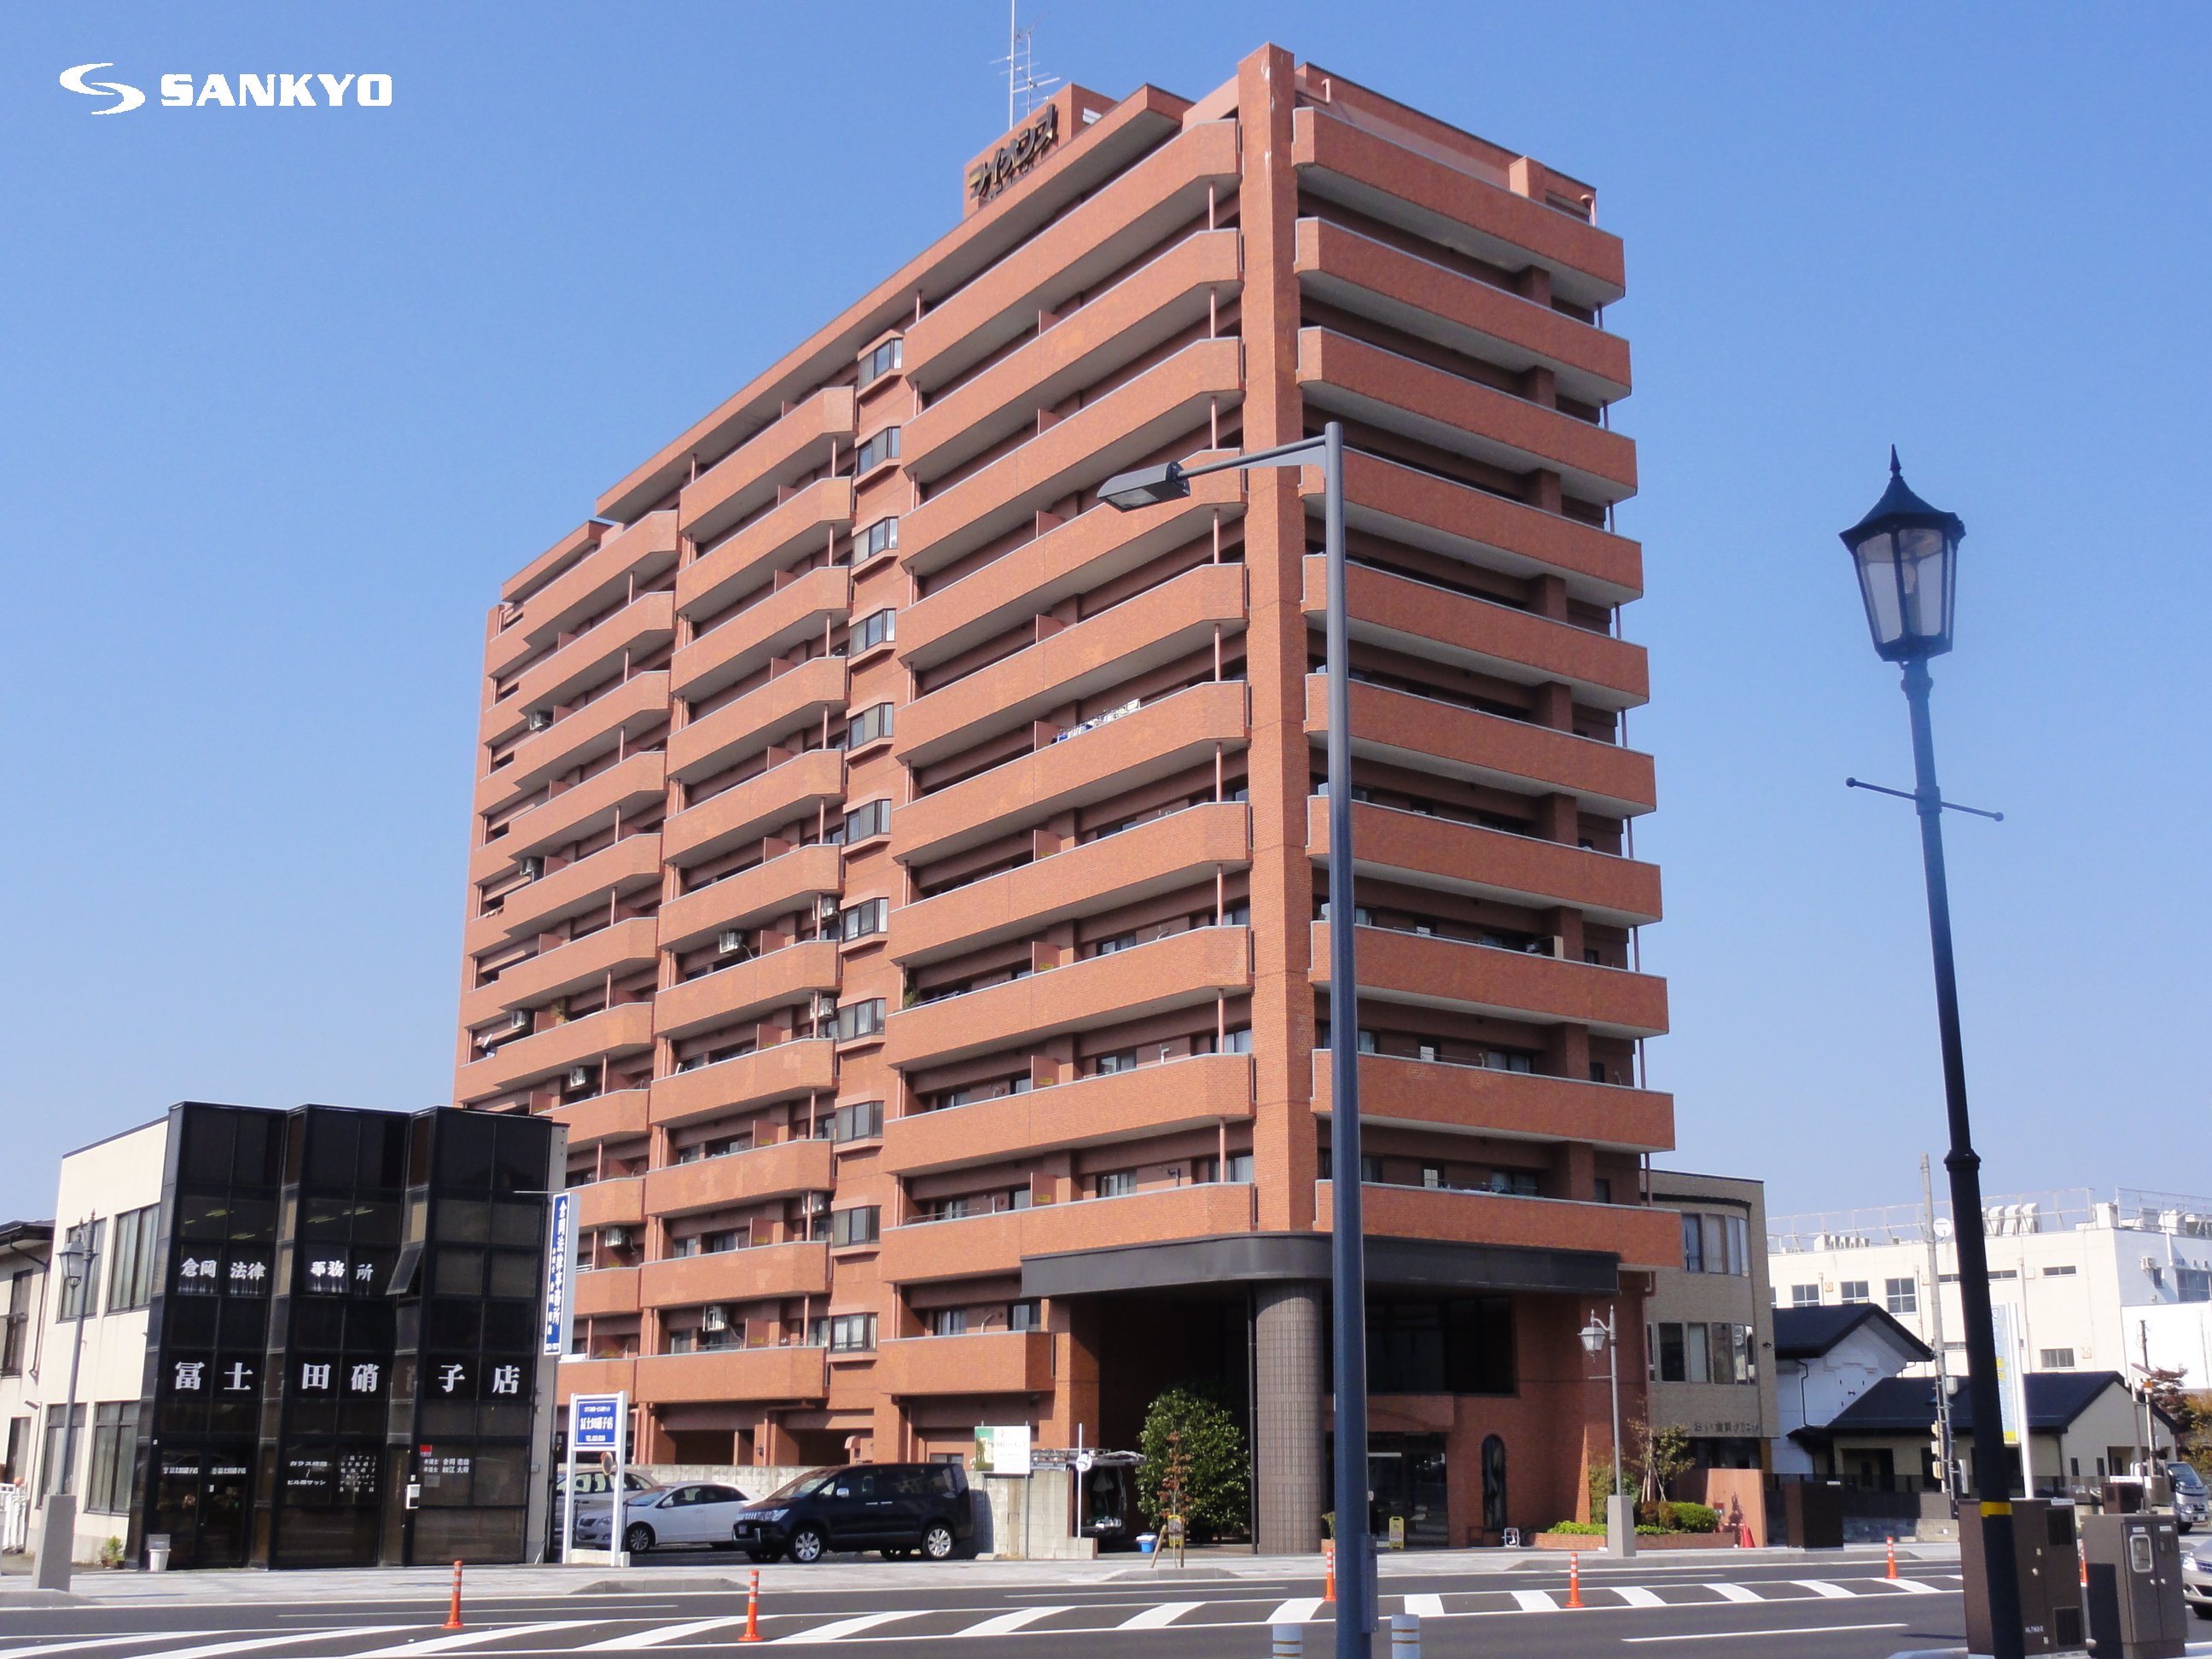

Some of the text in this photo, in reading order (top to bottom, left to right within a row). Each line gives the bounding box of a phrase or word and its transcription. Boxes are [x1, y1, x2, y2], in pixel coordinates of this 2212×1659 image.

[969, 103, 1057, 200] ライオンズ
